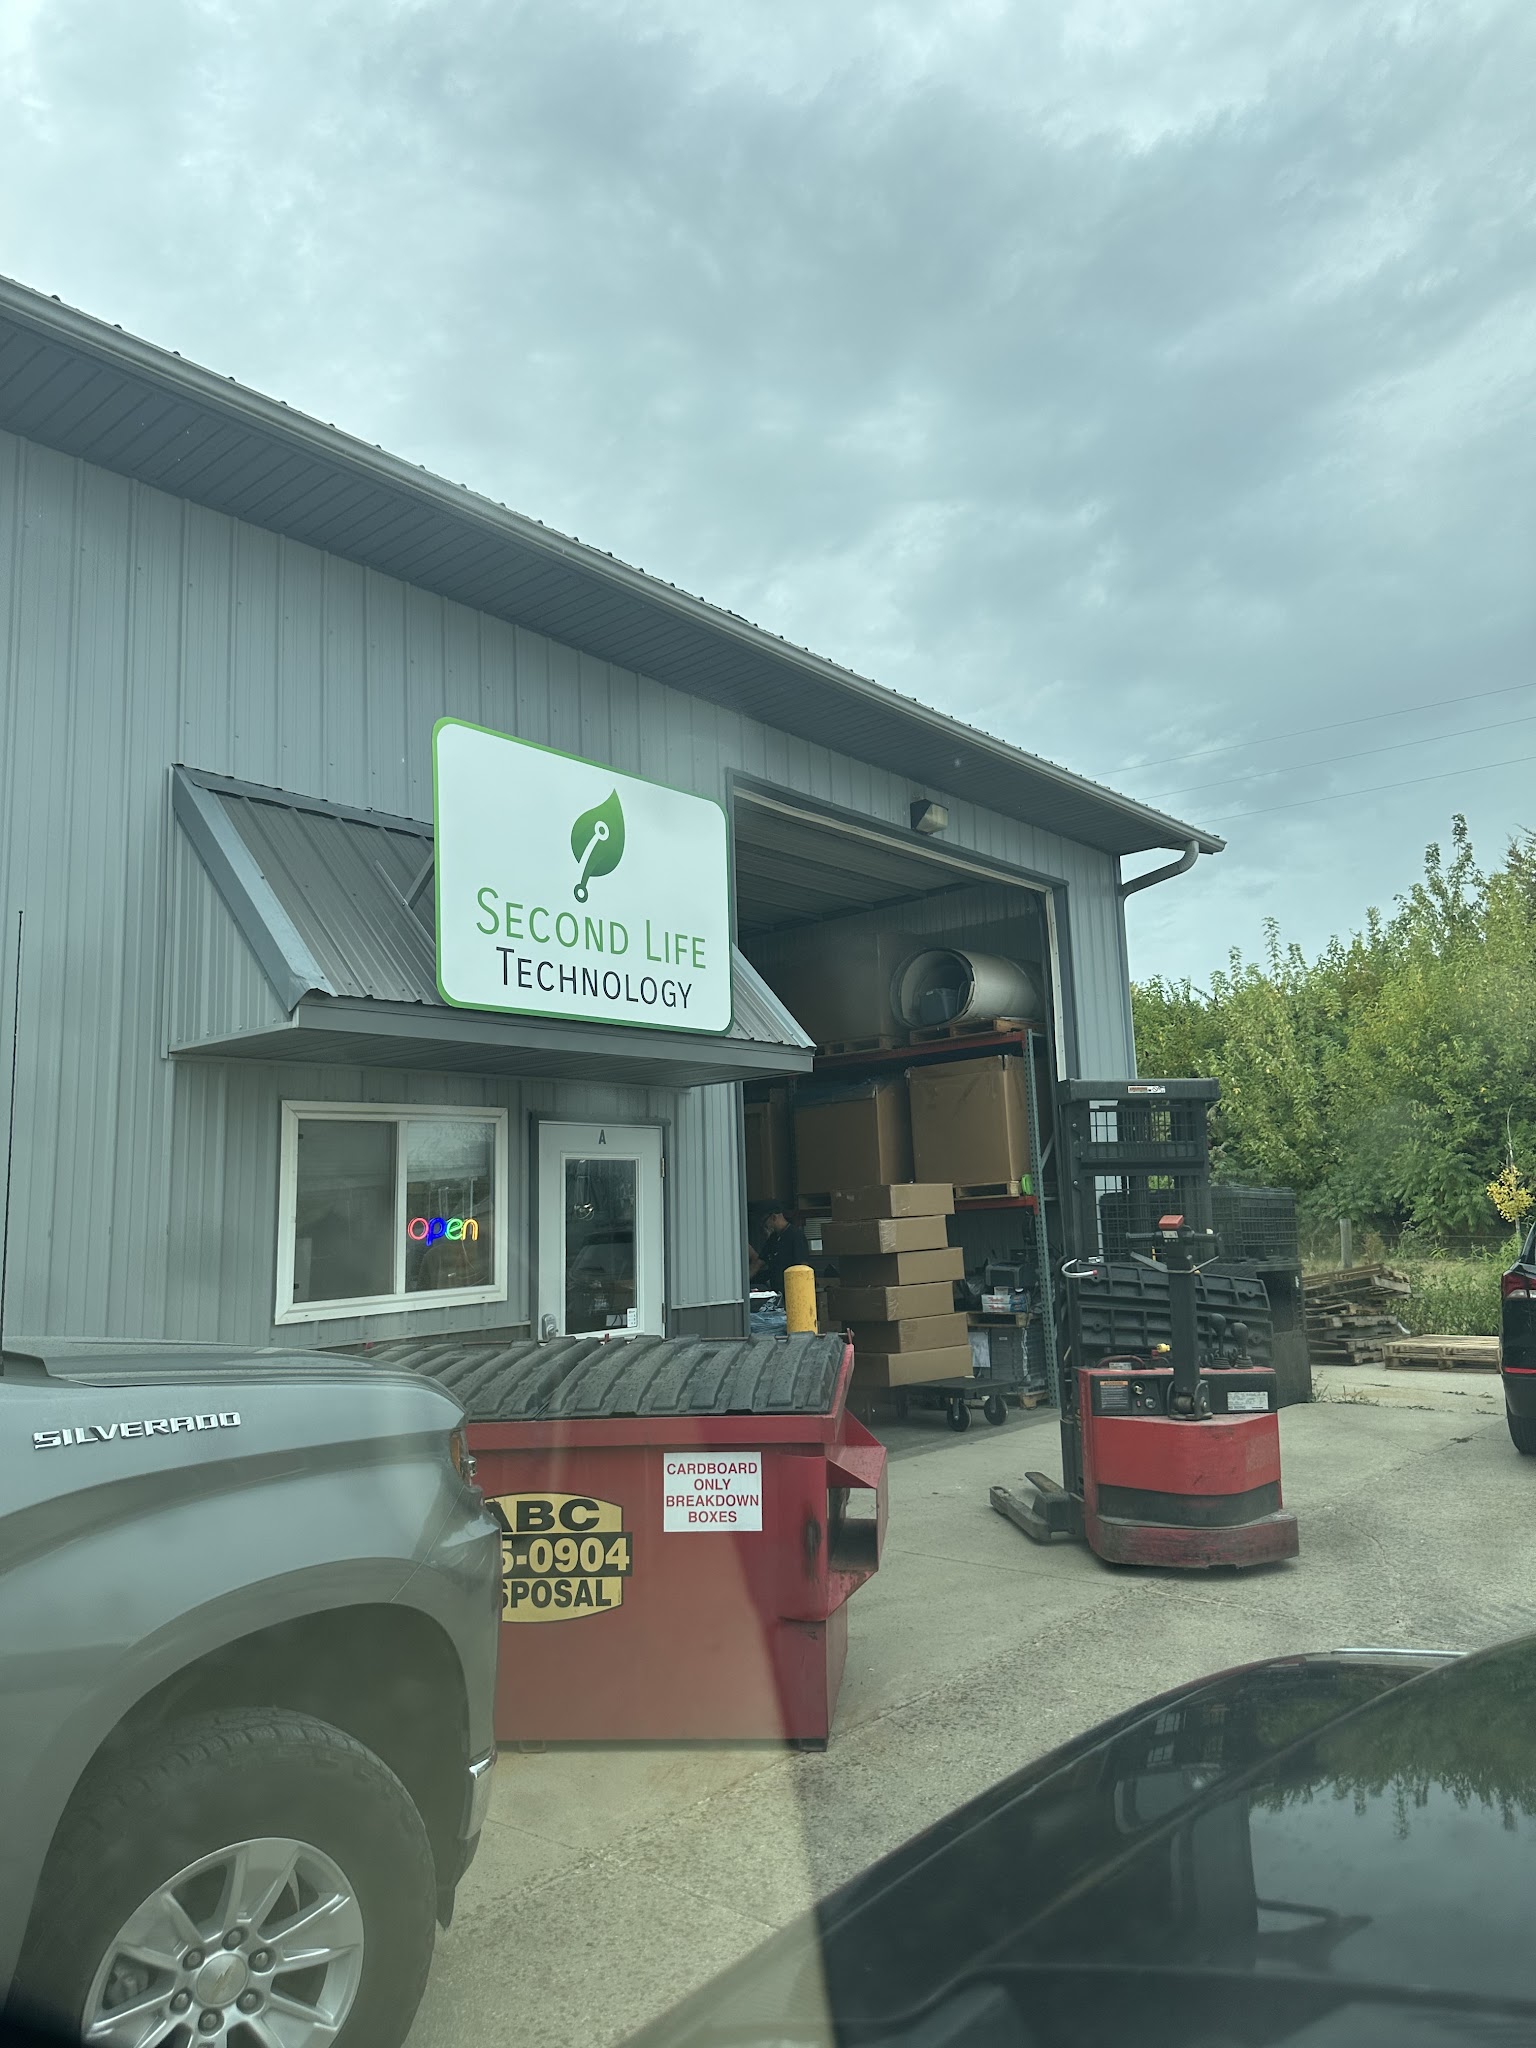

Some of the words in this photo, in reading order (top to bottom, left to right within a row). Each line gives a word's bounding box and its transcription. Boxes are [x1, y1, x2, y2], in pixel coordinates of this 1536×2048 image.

[476, 886, 629, 955] SECOND
[646, 919, 706, 969] LIFE
[496, 946, 692, 1009] TECHNOLOGY
[598, 1129, 606, 1144] A
[408, 1217, 479, 1246] open
[33, 1411, 241, 1450] SILVERADO
[666, 1462, 757, 1475] CARDBOARD
[694, 1478, 731, 1490] ONLY
[666, 1494, 759, 1507] BREAKDOWN
[688, 1510, 737, 1523] BOXES
